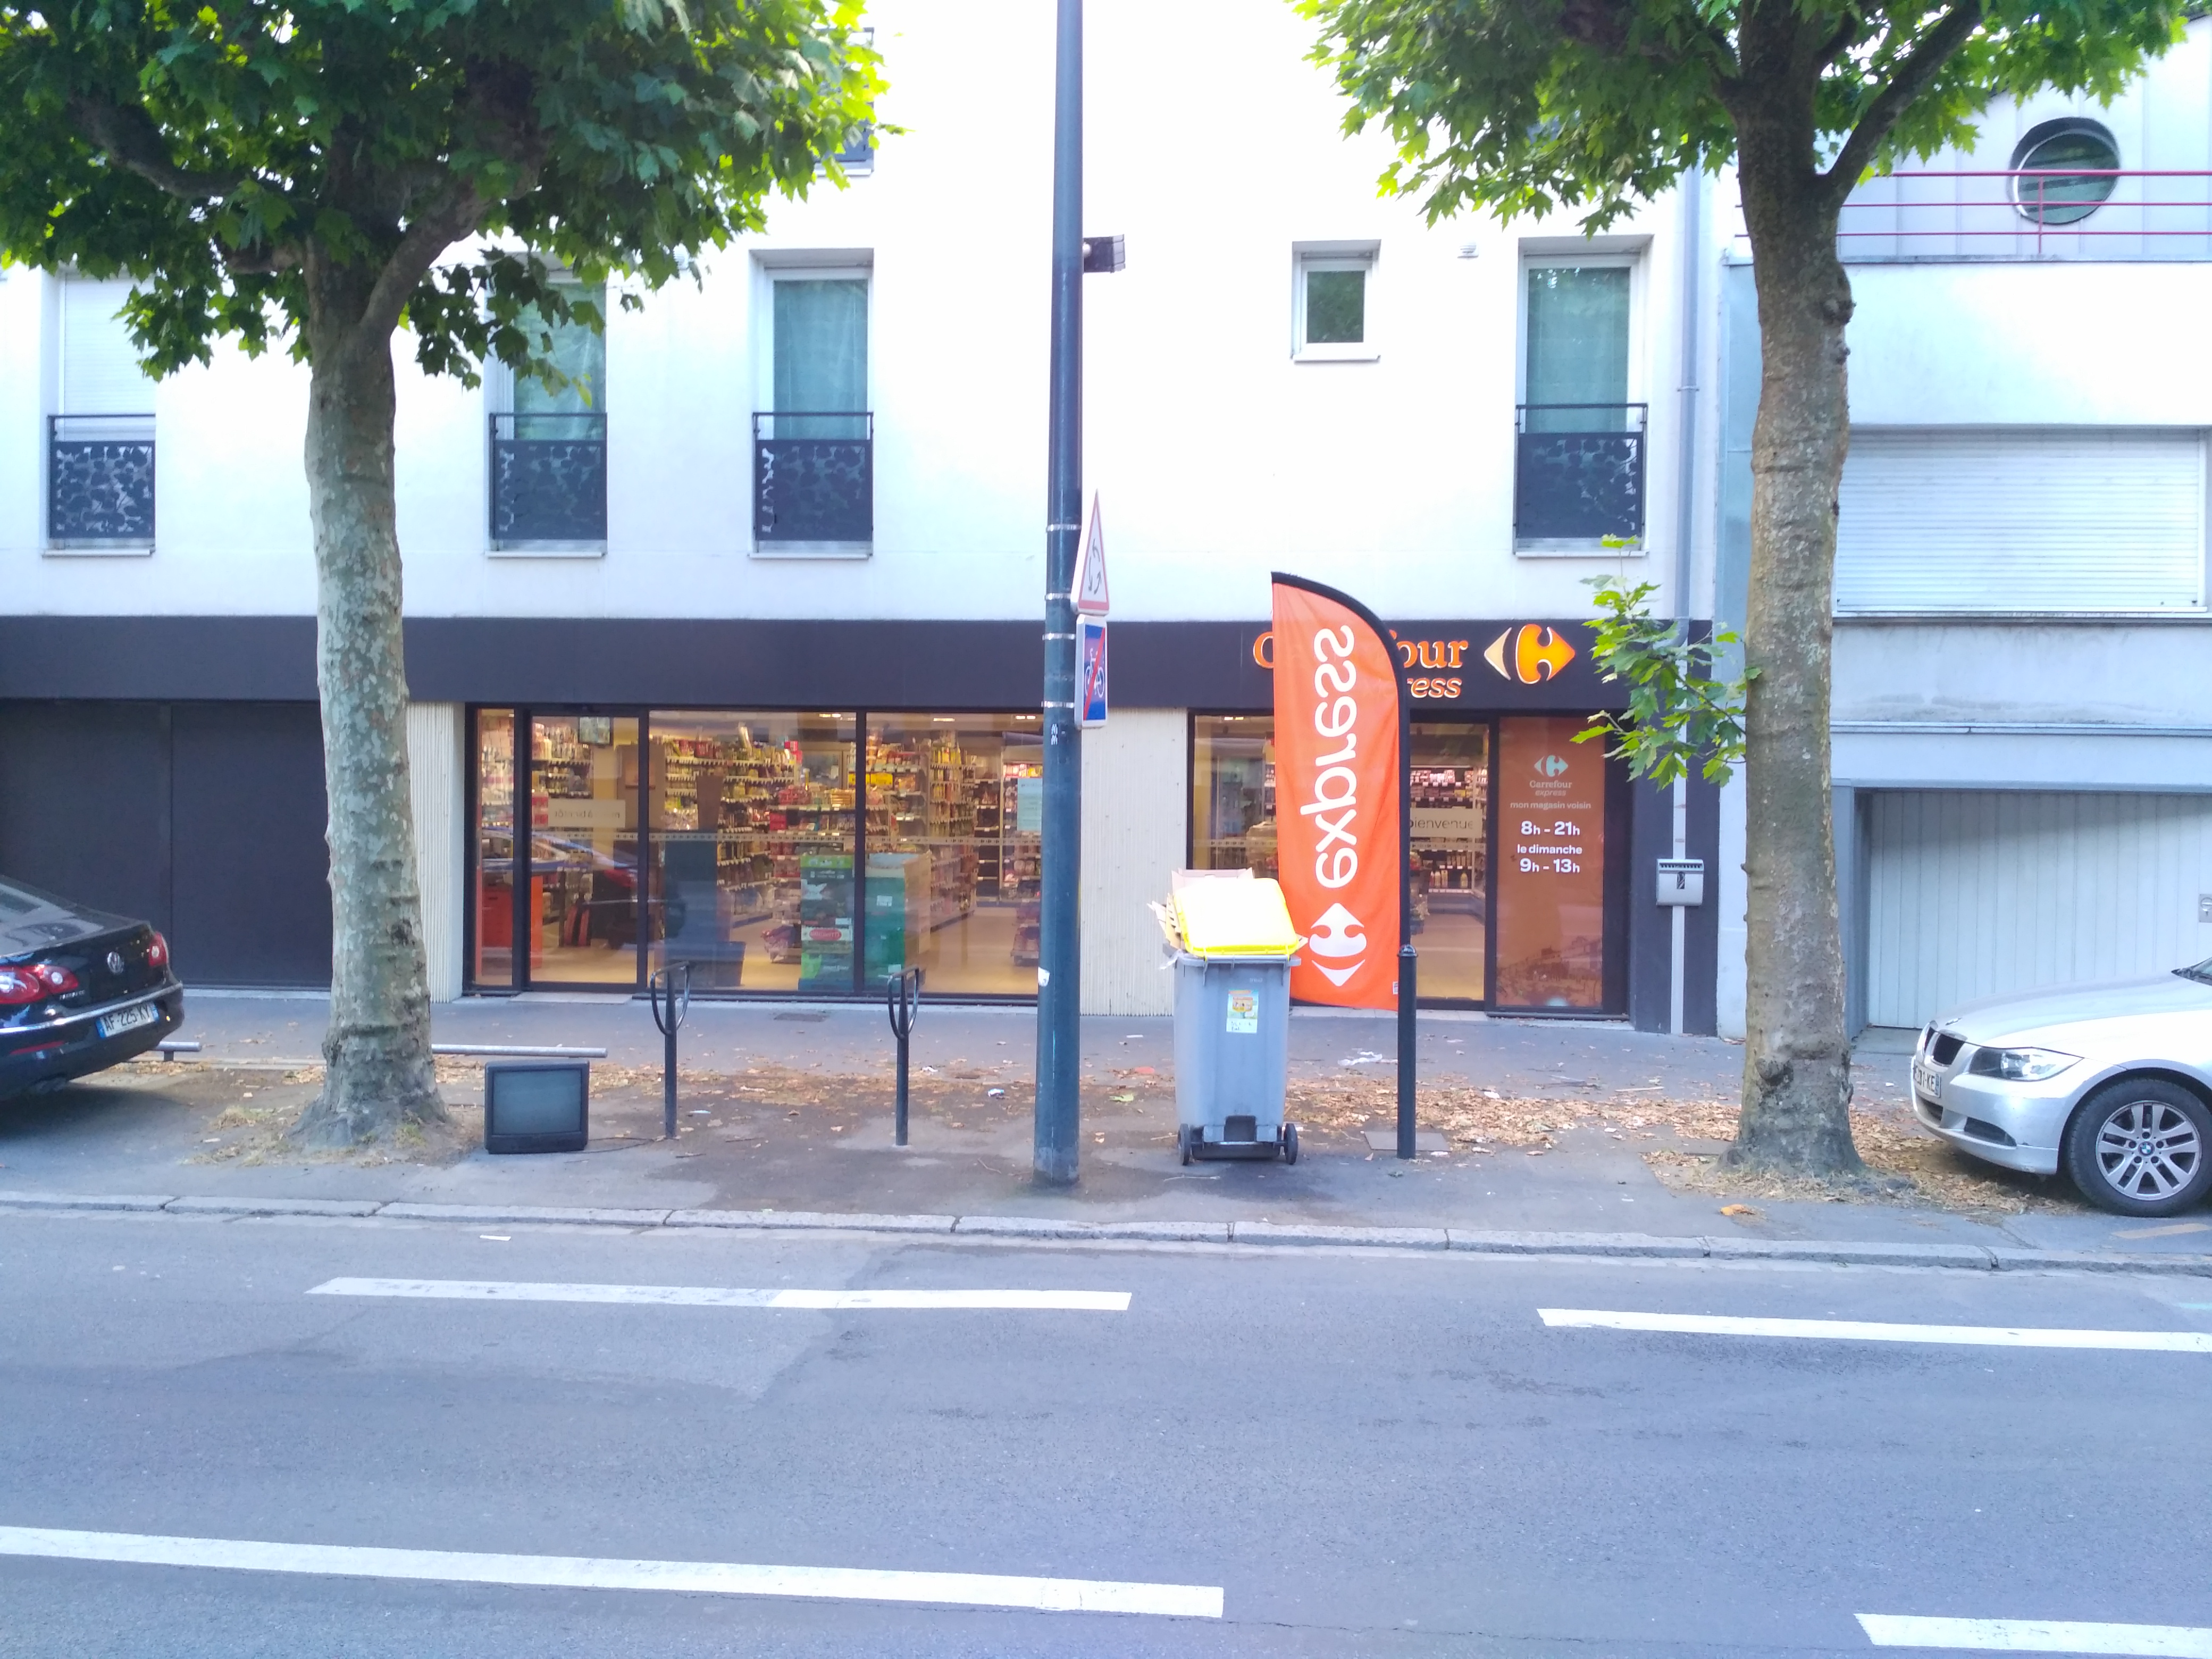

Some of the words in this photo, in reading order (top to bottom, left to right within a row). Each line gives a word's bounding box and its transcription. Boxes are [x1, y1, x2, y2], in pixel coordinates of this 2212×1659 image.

[1530, 801, 1565, 810] magasin
[1521, 820, 1540, 835] 8h
[1554, 821, 1580, 835] 21h
[1517, 844, 1527, 853] le
[1529, 844, 1582, 854] dimanche
[1520, 858, 1539, 872] 9h
[1553, 859, 1580, 873] 13h
